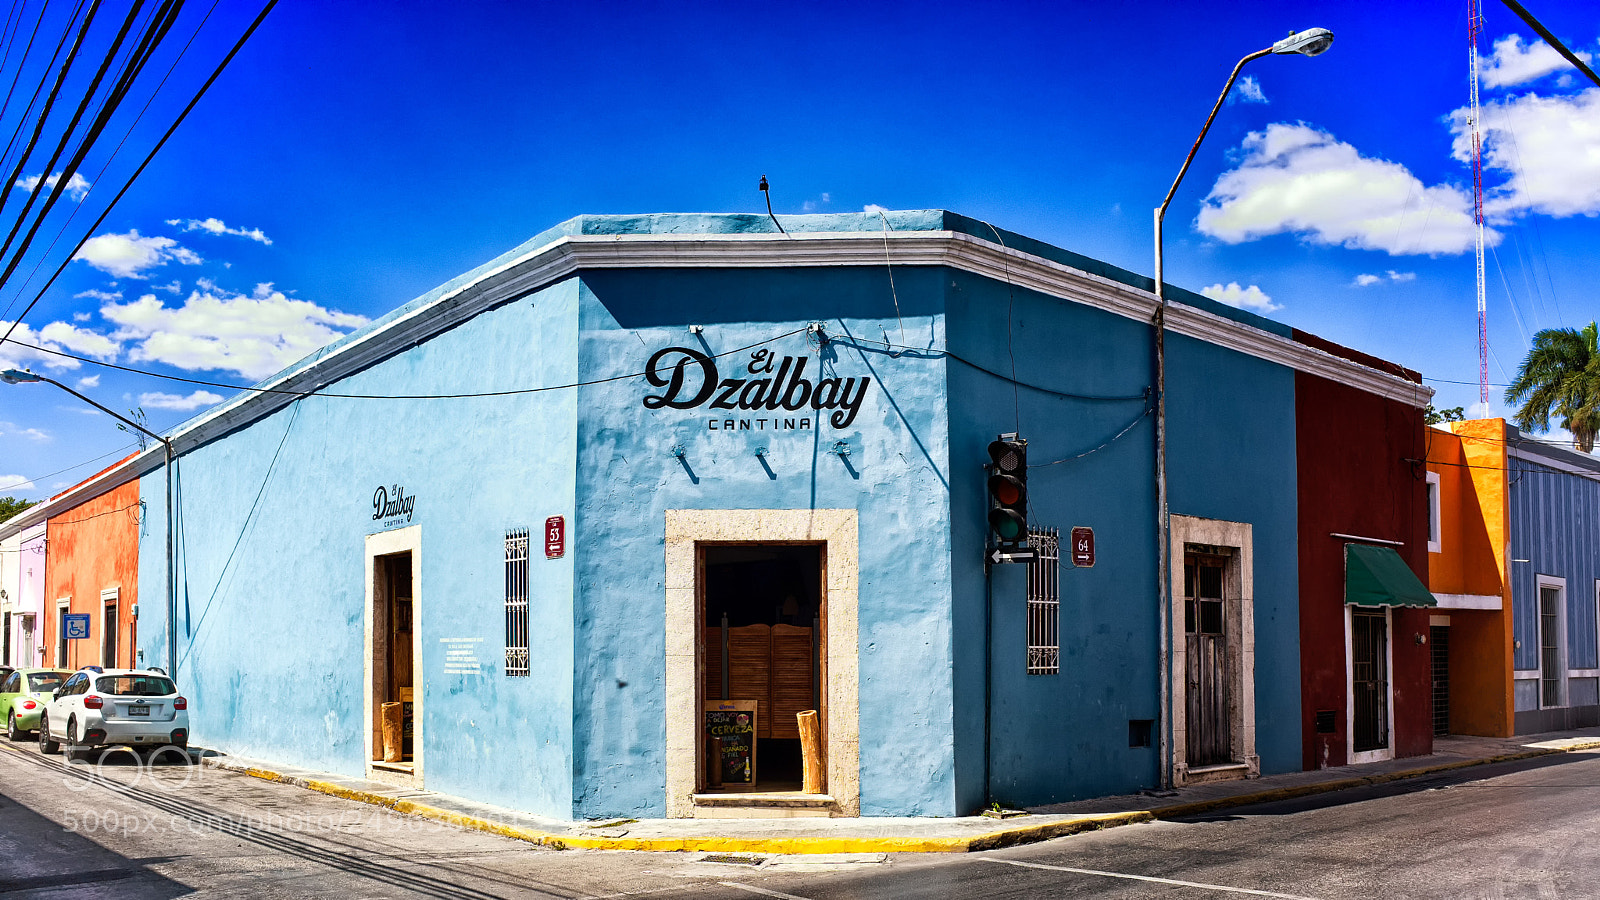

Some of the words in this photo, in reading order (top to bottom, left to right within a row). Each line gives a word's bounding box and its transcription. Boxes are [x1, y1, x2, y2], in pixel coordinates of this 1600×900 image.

[748, 348, 775, 374] El
[643, 346, 871, 430] Dzalbay
[708, 418, 811, 431] CANTINA
[372, 485, 416, 523] Dzalbay
[384, 518, 404, 528] CANTINA
[549, 527, 560, 542] 53
[1078, 538, 1089, 552] 64
[711, 724, 753, 735] CERVEZA
